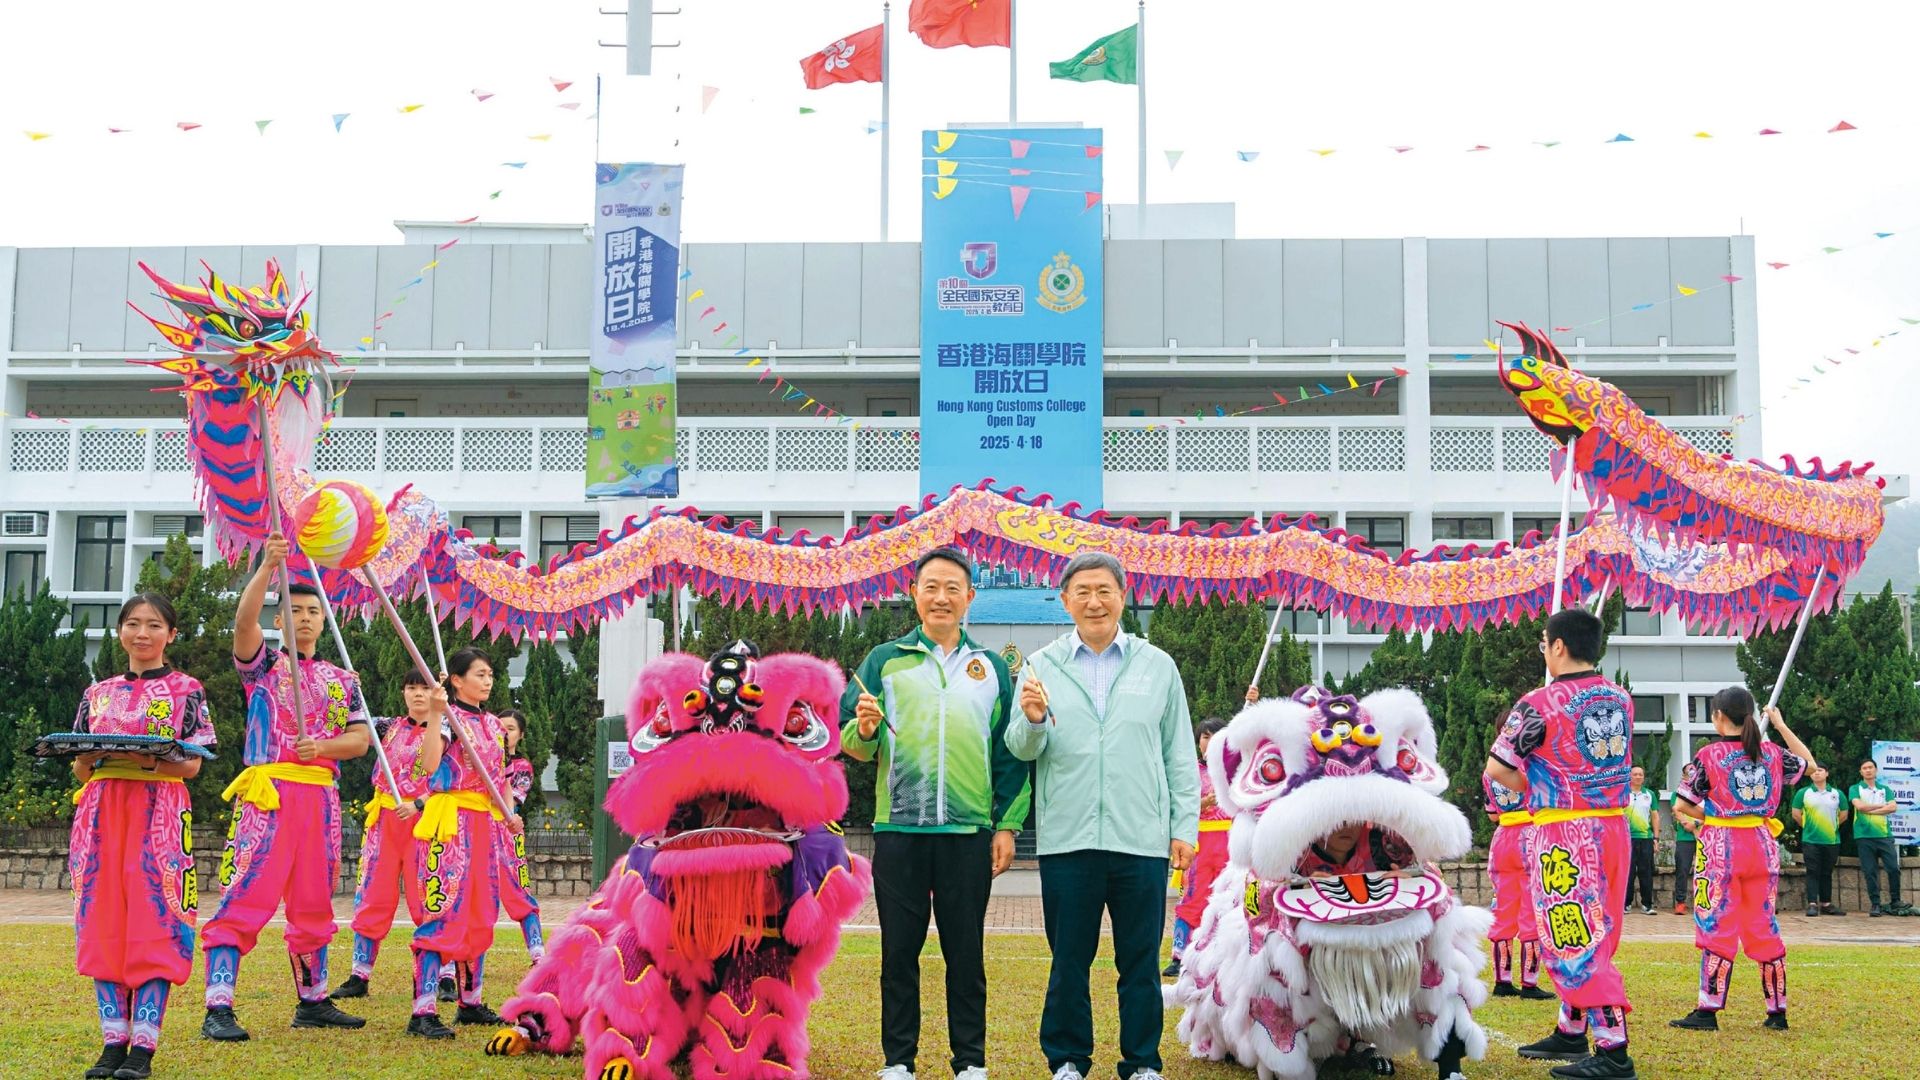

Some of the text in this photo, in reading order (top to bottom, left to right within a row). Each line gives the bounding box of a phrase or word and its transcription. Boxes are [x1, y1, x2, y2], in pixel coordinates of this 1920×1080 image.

[607, 228, 637, 325] 開放日
[637, 235, 654, 316] 香港海關學院
[942, 289, 1020, 302] 全民國家安全
[992, 302, 1024, 313] 教育日
[937, 342, 1086, 367] 香港海關學院
[974, 369, 1048, 393] 開放日
[937, 400, 1086, 413] Hong Kong Customs College
[987, 414, 1036, 428] Open Day
[1540, 845, 1592, 949] 海關
